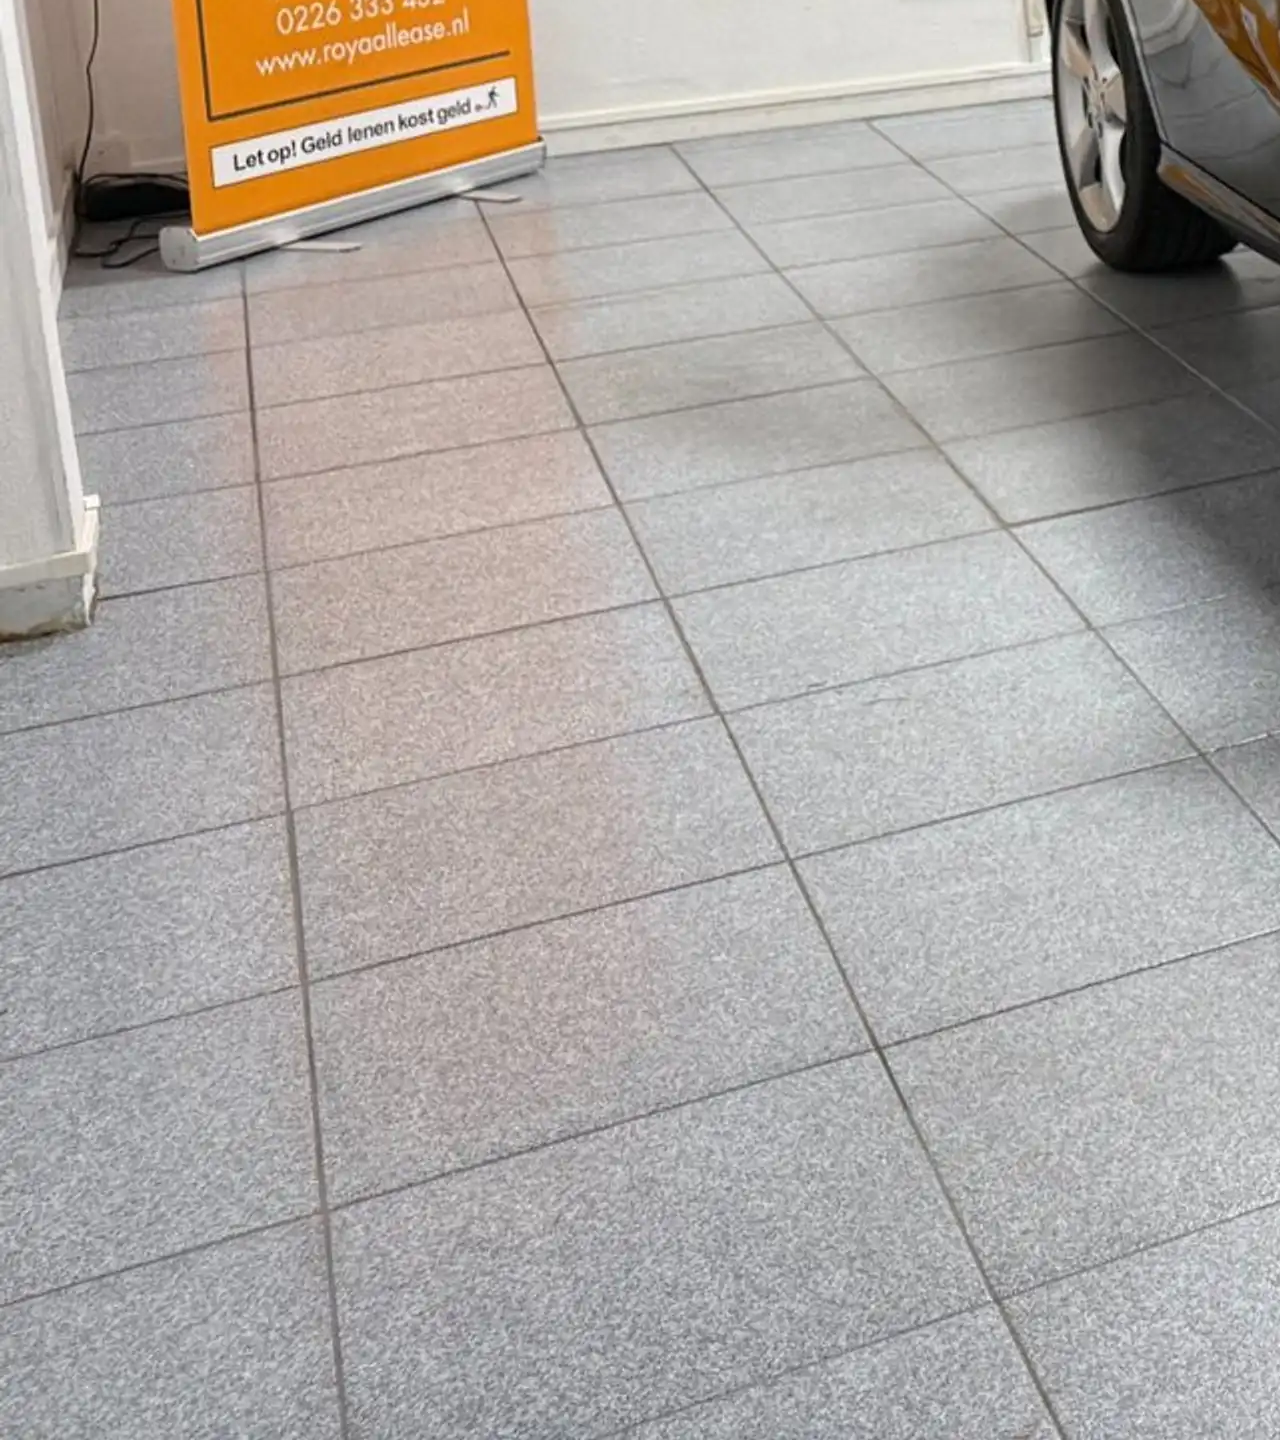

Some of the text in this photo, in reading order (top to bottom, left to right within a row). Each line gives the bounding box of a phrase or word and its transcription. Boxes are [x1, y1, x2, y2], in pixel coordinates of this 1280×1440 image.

[255, 9, 470, 76] www.royaallease.nl
[276, 5, 341, 35] 0226
[233, 98, 471, 173] Let op! Geld lenen kost geld
